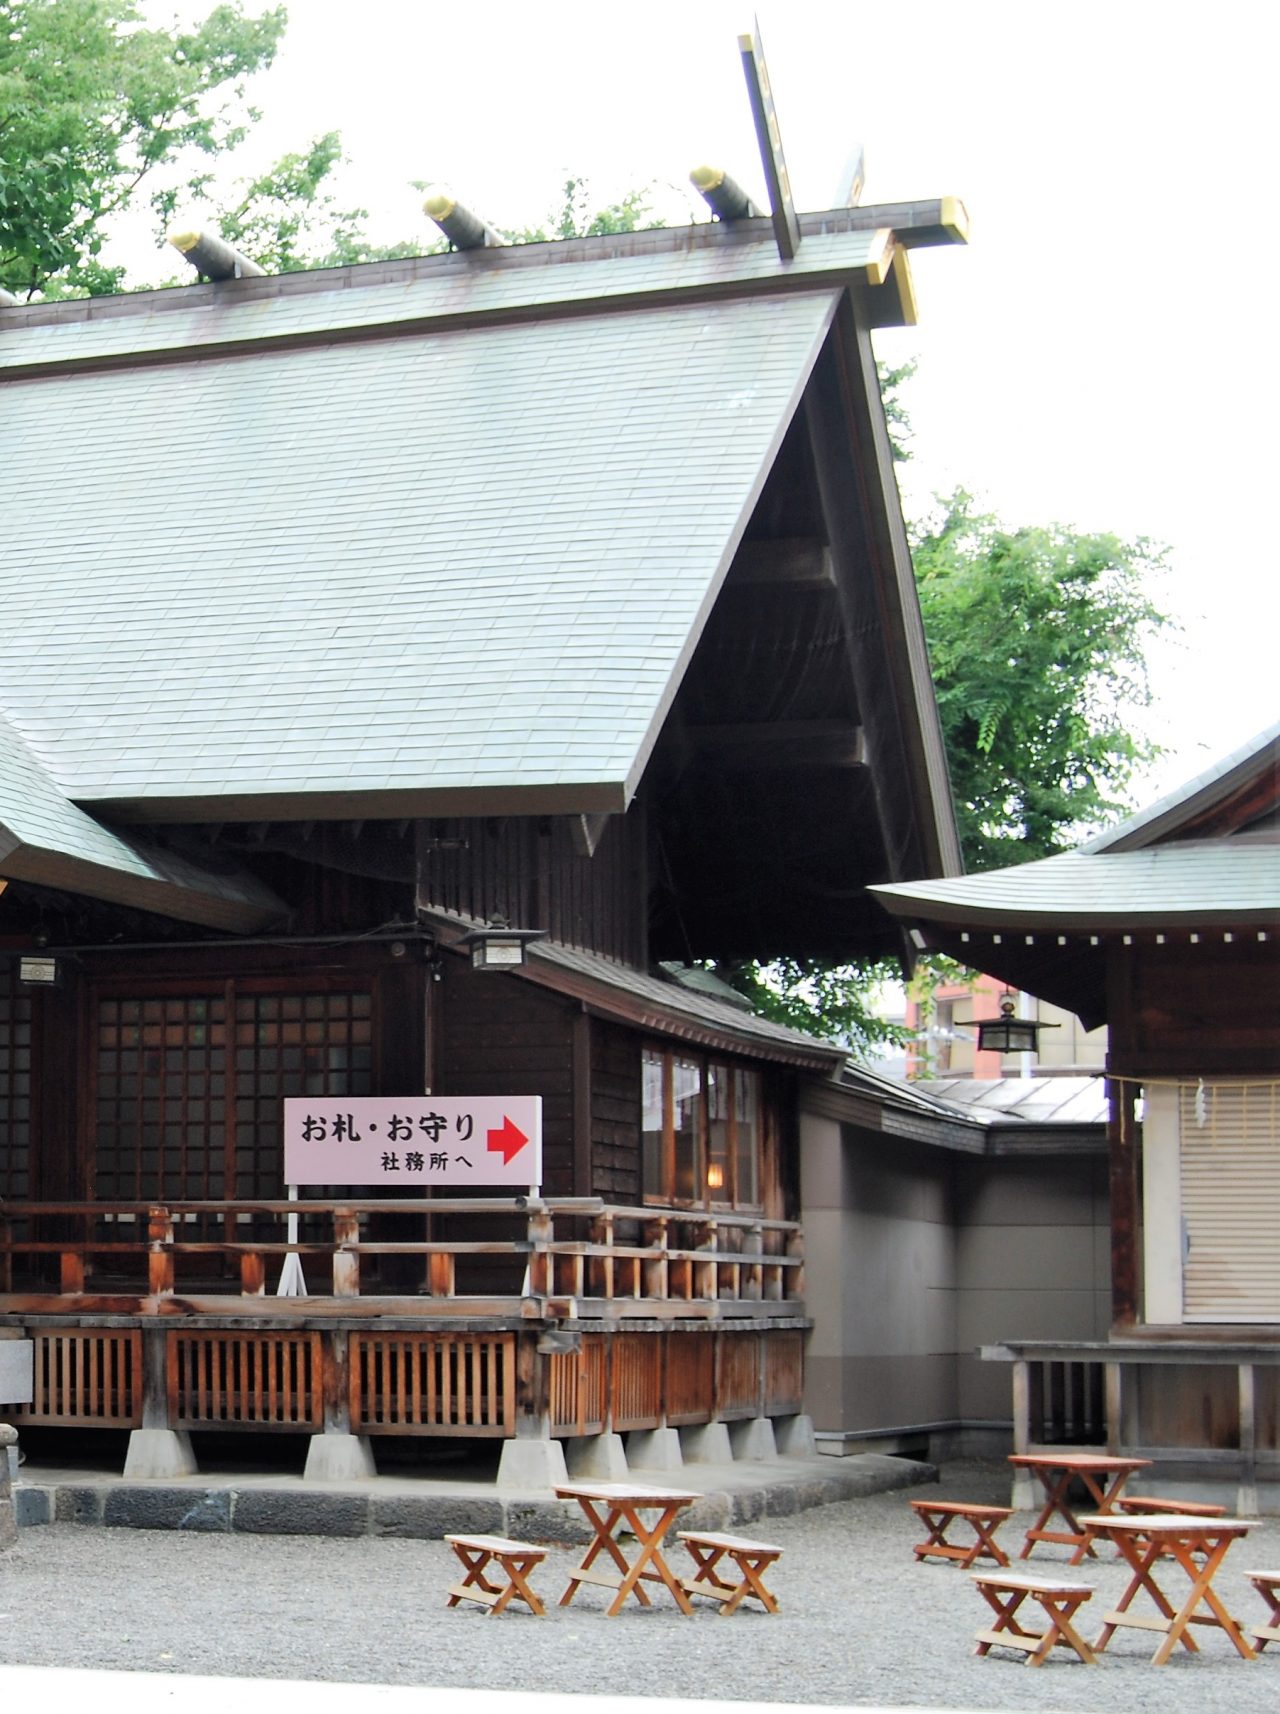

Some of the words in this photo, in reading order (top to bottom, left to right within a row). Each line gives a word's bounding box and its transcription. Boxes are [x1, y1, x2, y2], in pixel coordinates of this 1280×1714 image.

[301, 1111, 474, 1144] お札・お守り
[380, 1150, 473, 1172] 社務所へ
